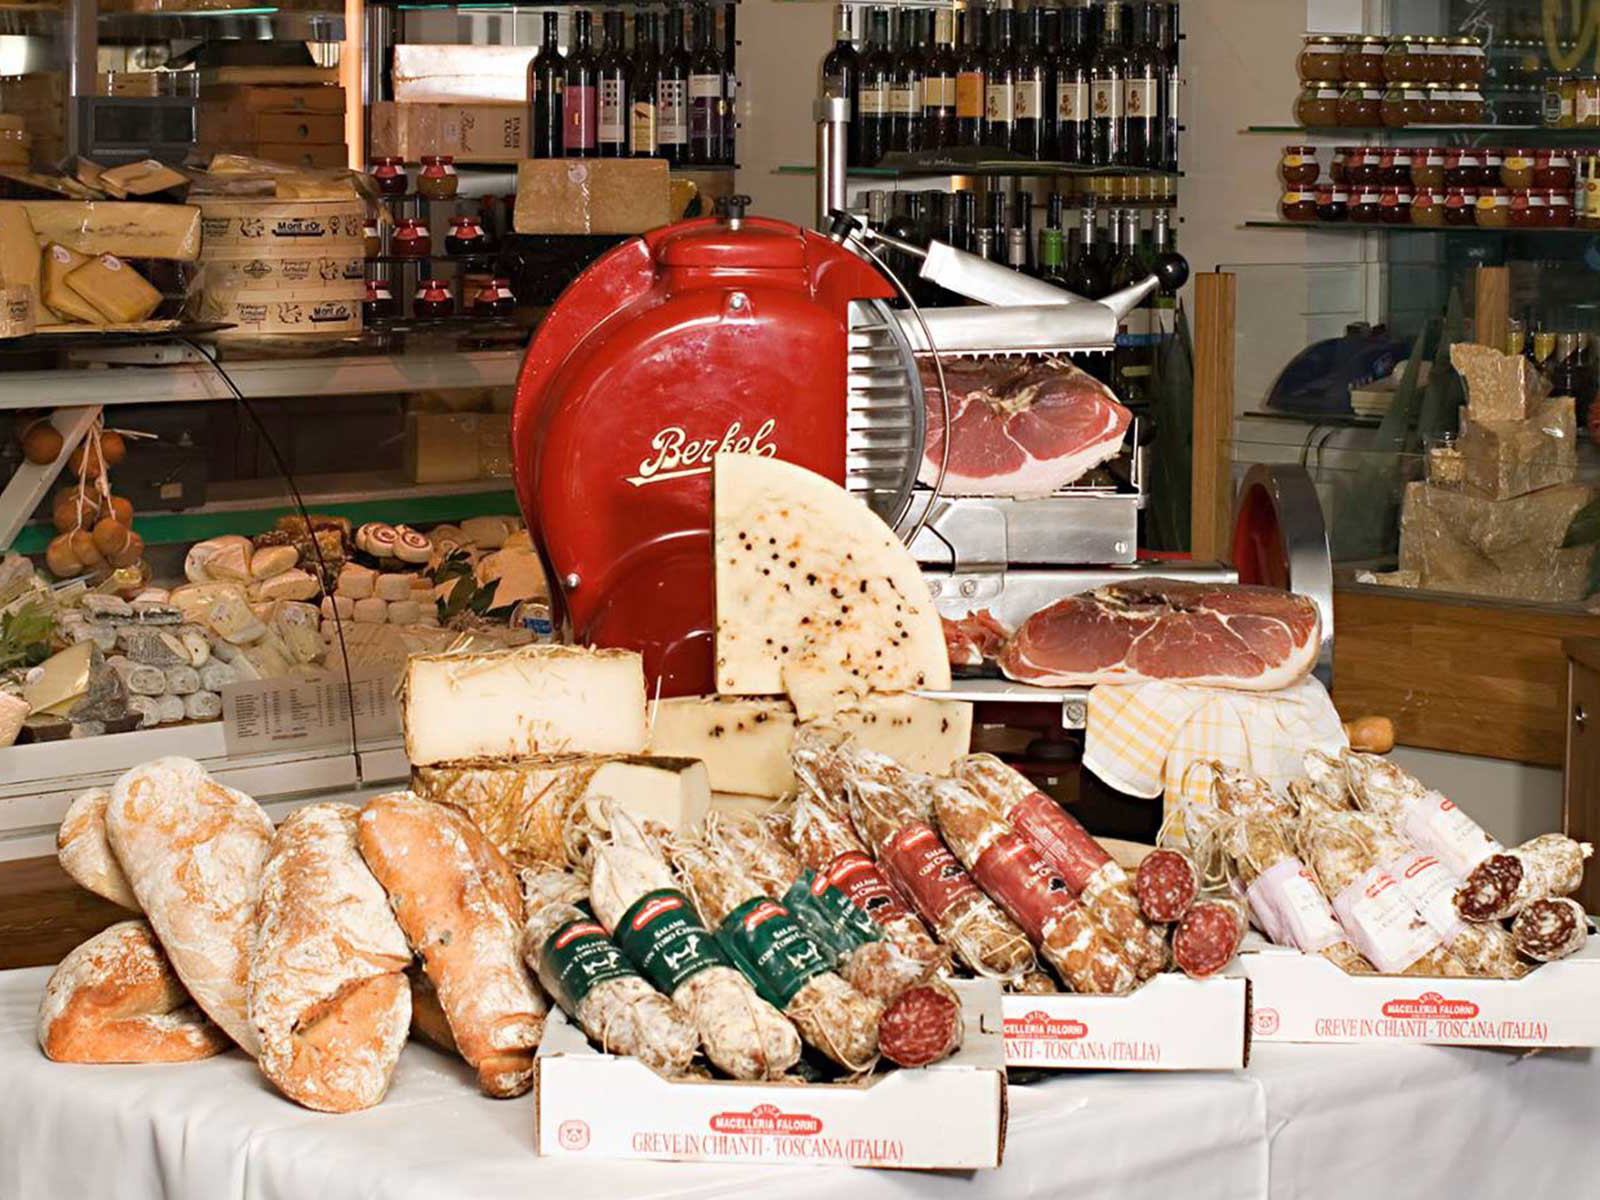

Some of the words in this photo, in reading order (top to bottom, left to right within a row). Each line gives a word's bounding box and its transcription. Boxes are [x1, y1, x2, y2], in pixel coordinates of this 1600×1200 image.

[277, 222, 302, 231] Mont
[313, 307, 334, 315] Mont
[639, 418, 777, 477] Berkel
[654, 918, 687, 939] SALAME
[1387, 1004, 1438, 1014] MACELLERIA
[1439, 1004, 1475, 1015] FALORNI
[1003, 1023, 1045, 1035] CELLERIA
[1047, 1024, 1084, 1035] FALORNI
[1315, 1018, 1358, 1037] GREVE
[1360, 1019, 1374, 1037] IN
[1375, 1019, 1428, 1039] CHIANTI
[1436, 1021, 1497, 1040] TOSCANA
[1497, 1022, 1549, 1041] (ITALIA)
[1004, 1041, 1034, 1059] ANTI
[1043, 1041, 1107, 1061] TOSCANA
[1108, 1042, 1161, 1063] (ITALIA)
[715, 1117, 775, 1130] MACELLERIA
[776, 1119, 818, 1131] FALORNI
[632, 1132, 682, 1154] GREVE
[684, 1134, 700, 1154] IN
[702, 1135, 764, 1156] CHIANTI
[773, 1137, 844, 1159] TOSCANA
[845, 1139, 904, 1162] (ITALIA)
